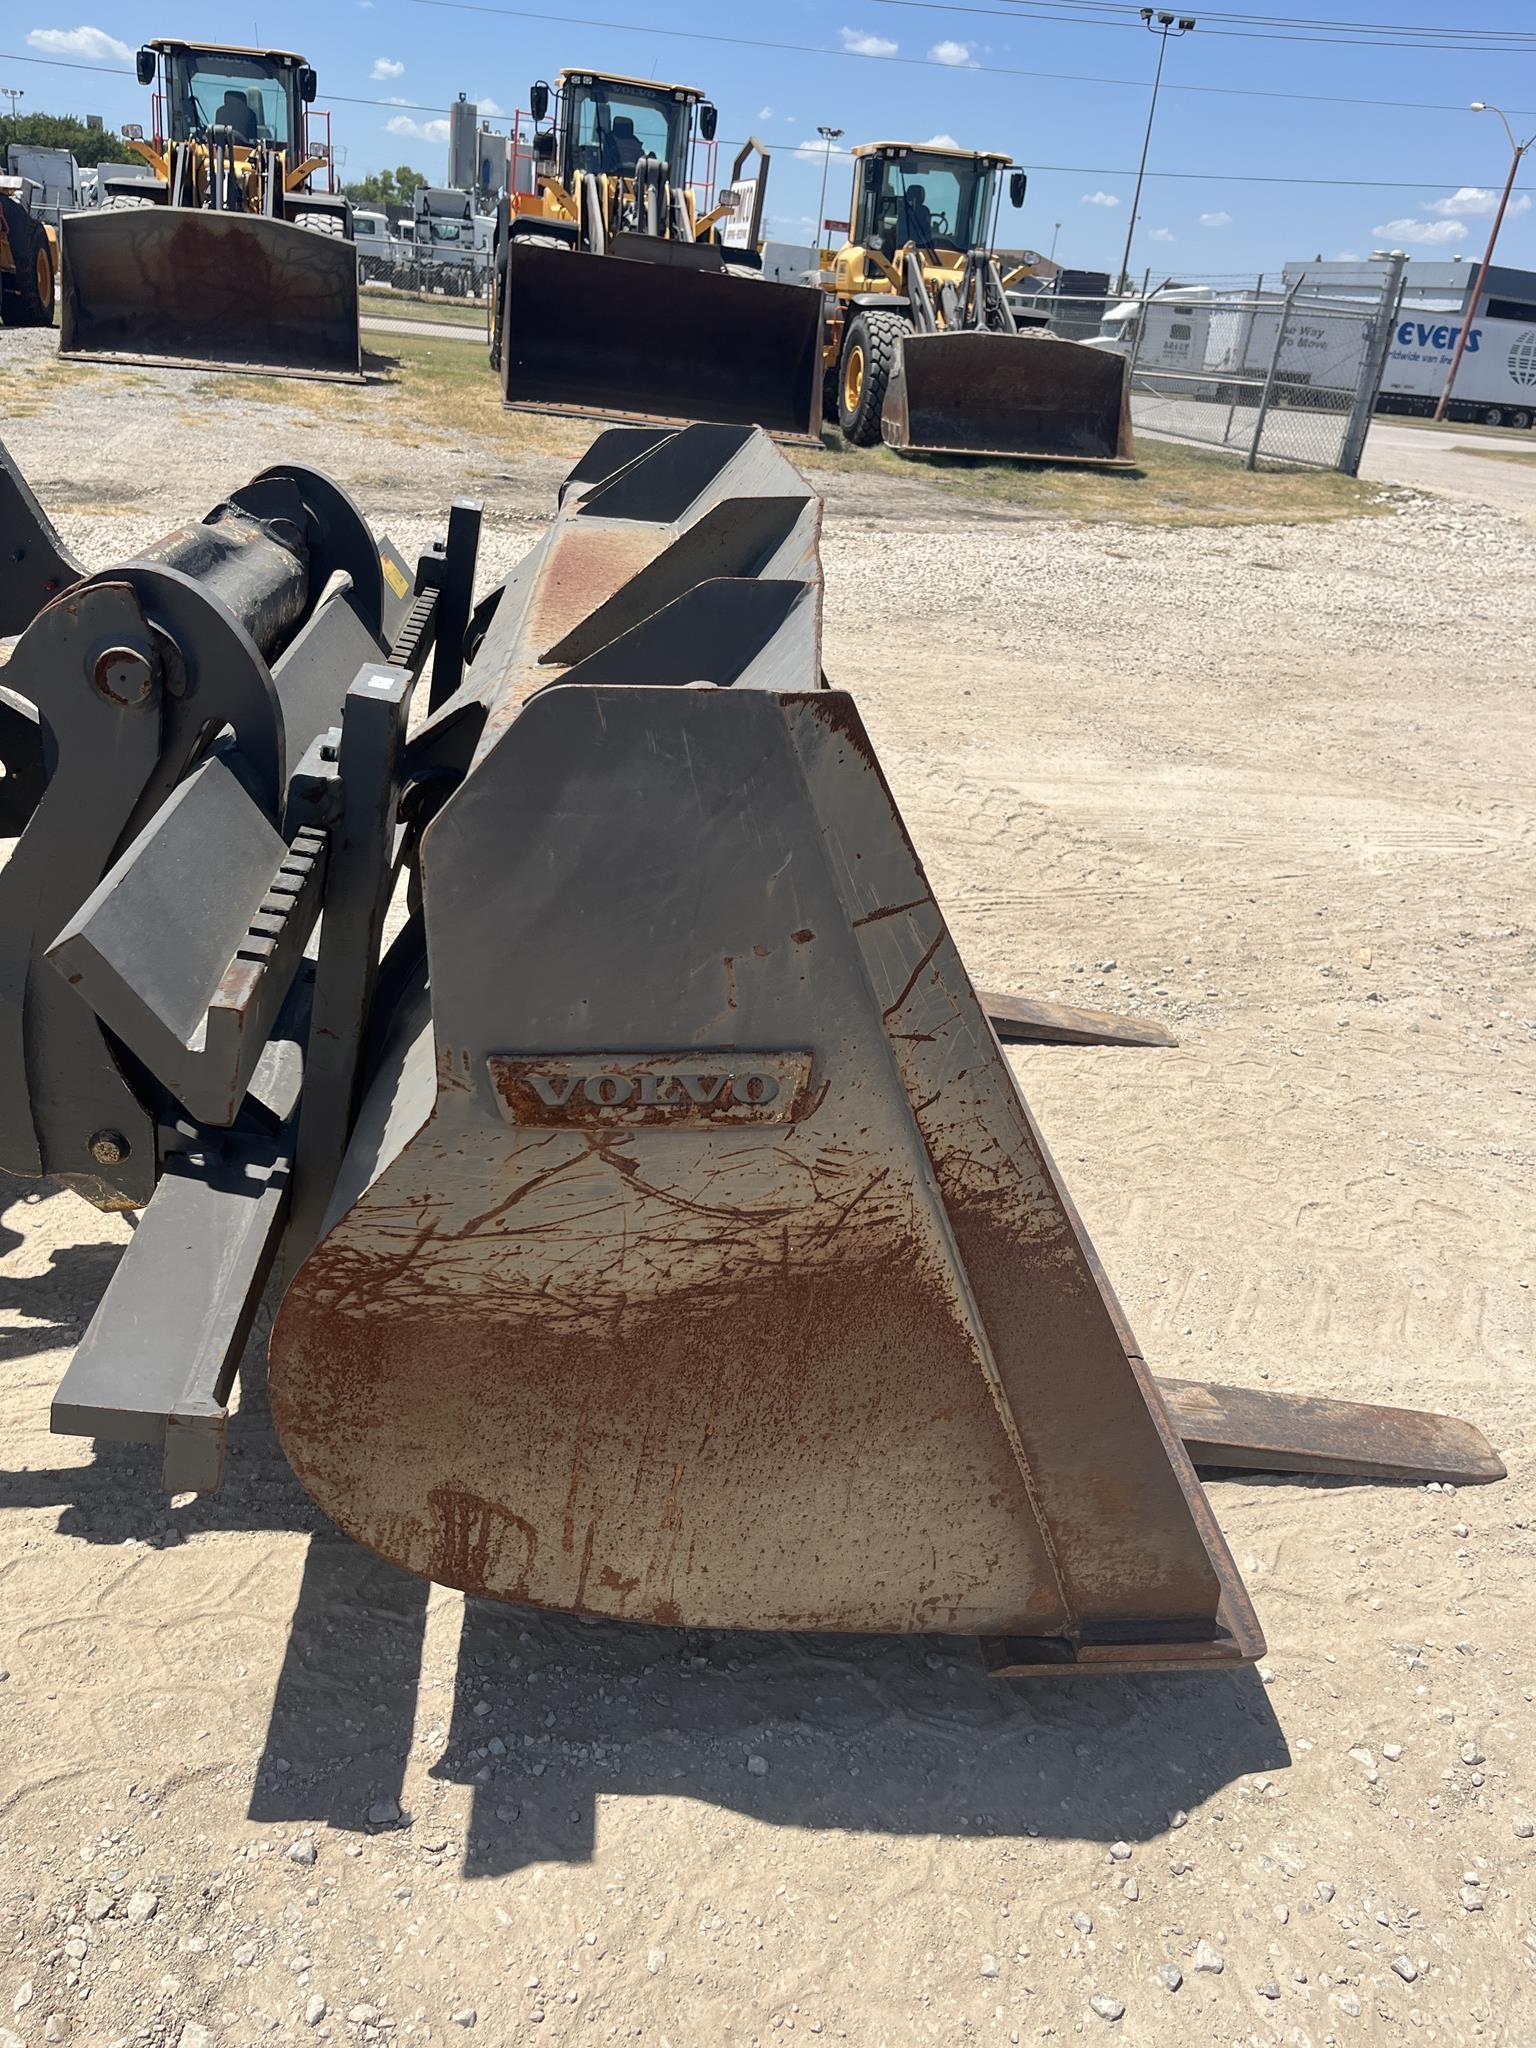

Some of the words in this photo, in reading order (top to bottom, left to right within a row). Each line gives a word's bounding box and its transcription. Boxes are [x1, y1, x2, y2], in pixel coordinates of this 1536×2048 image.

[610, 83, 657, 98] VOLVO
[1299, 326, 1325, 339] Way
[1297, 337, 1329, 349] Move
[519, 1073, 781, 1107] VOLVO
